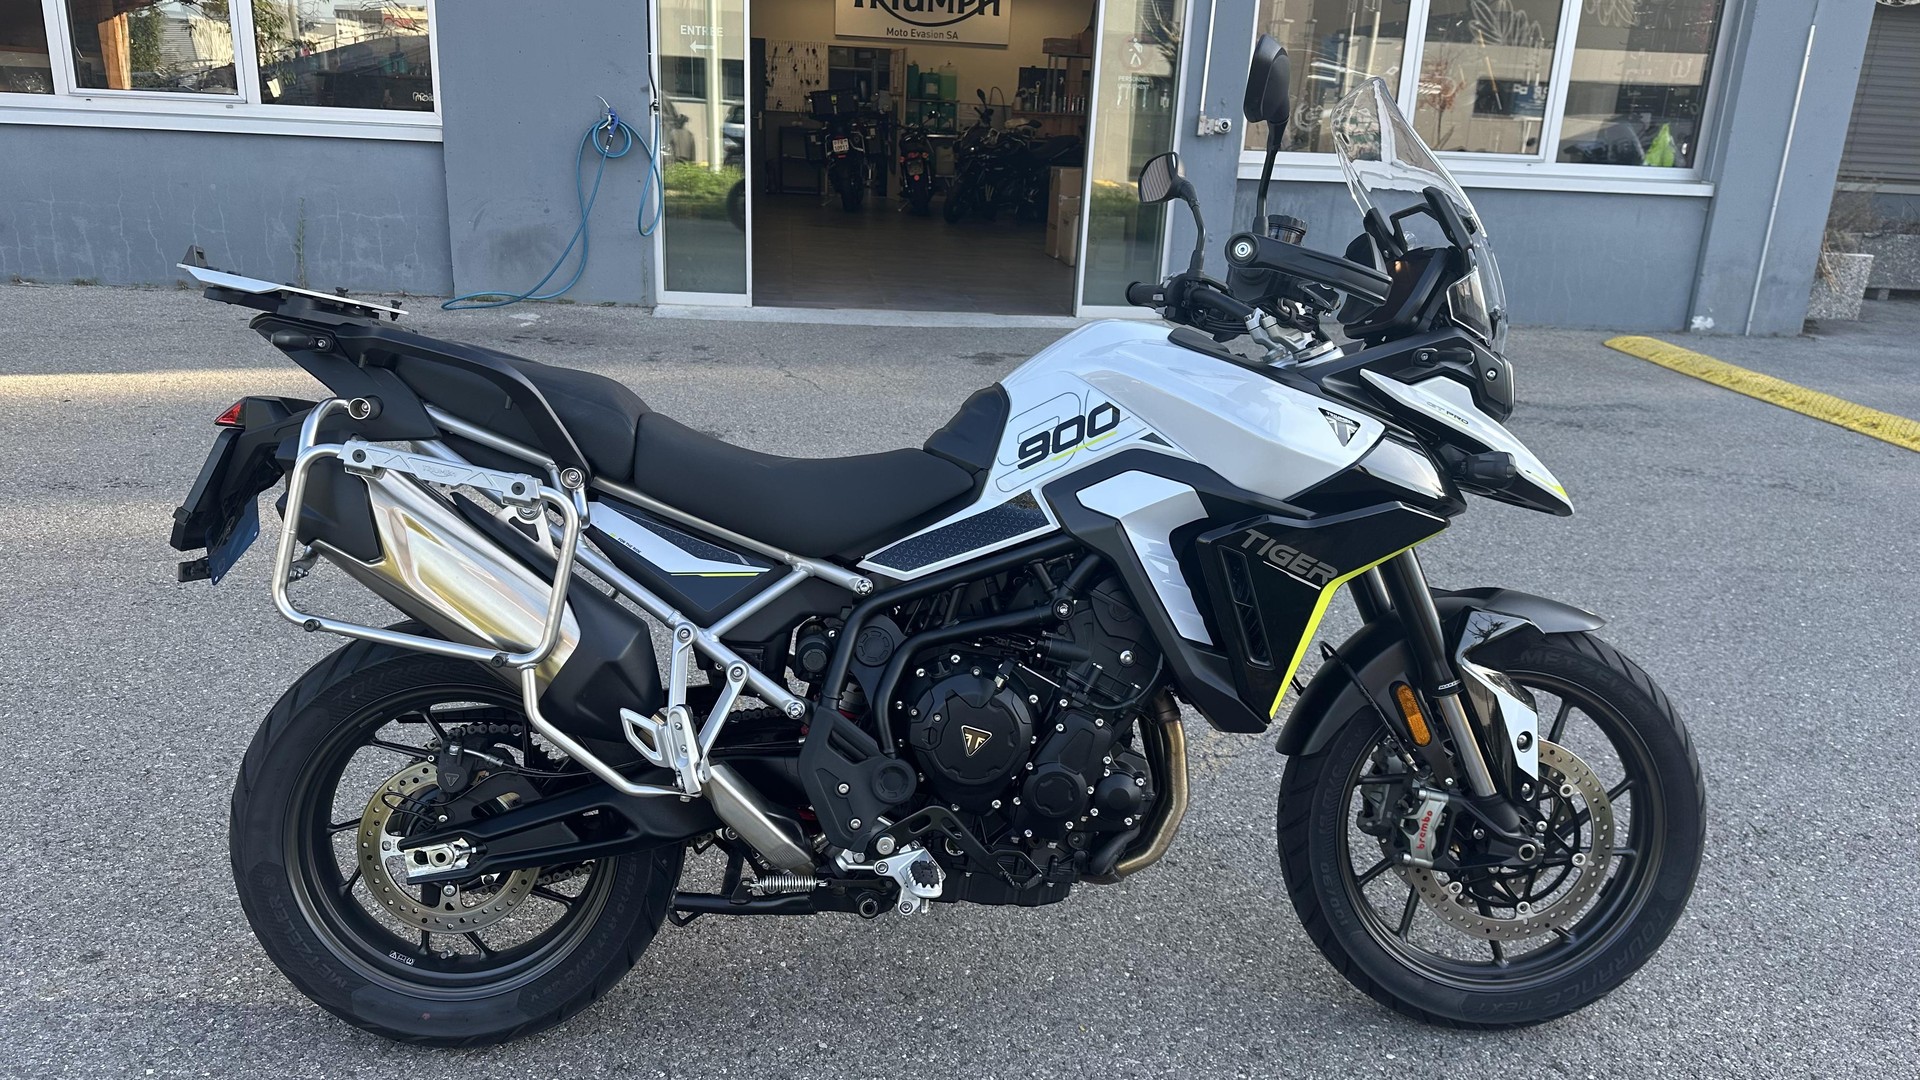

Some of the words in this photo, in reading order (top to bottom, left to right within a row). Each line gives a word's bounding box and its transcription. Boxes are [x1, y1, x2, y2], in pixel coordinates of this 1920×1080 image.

[886, 27, 908, 38] Moto
[911, 28, 944, 39] Evasion
[946, 31, 959, 40] SA
[1018, 401, 1120, 470] 900
[1446, 411, 1469, 425] PRO
[1241, 528, 1338, 585] TIGER
[1416, 810, 1433, 850] brembo
[1543, 908, 1675, 1008] TOURANCE
